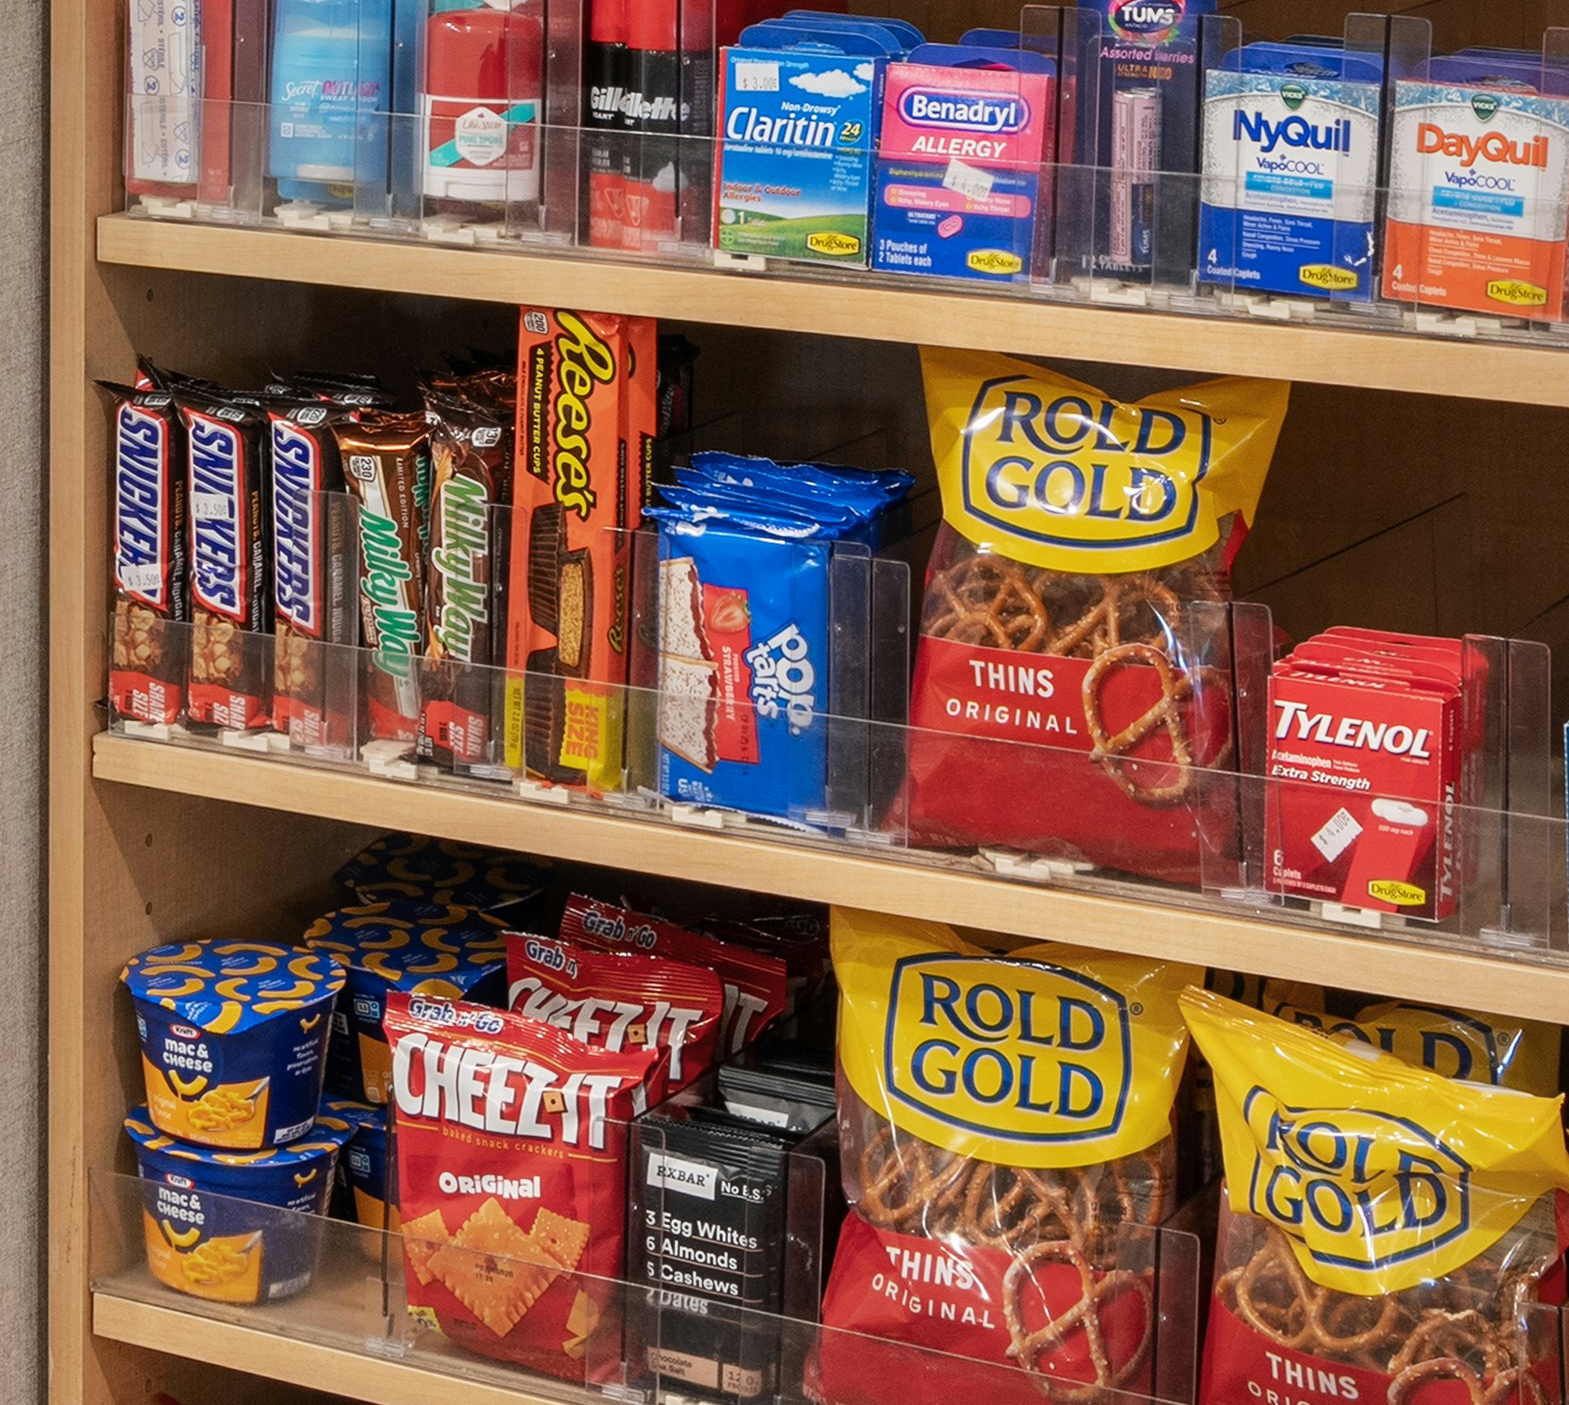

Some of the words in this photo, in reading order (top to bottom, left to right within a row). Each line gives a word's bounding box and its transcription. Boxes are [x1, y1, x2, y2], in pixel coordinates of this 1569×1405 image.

[1122, 6, 1174, 25] TUMS
[1100, 47, 1152, 60] Assorted
[281, 80, 323, 102] Secret
[781, 101, 838, 116] Non-Drowsy
[1282, 89, 1304, 100] VICKS
[1472, 100, 1496, 112] VICKS
[727, 106, 835, 146] Claritin
[841, 122, 861, 136] 24
[912, 94, 1017, 133] Benadryl
[1233, 109, 1351, 155] NyQuil
[911, 136, 1007, 158] ALLERGY
[1416, 122, 1549, 168] DayQuil
[723, 182, 752, 192] Indoor
[764, 185, 801, 196] Outdoor
[723, 192, 761, 202] Allergies
[879, 252, 883, 262] 2
[886, 252, 912, 265] Tablets
[914, 255, 932, 267] each
[886, 241, 917, 253] Pouches
[533, 358, 544, 400] PEANUT
[533, 403, 541, 445] BUTTER
[996, 390, 1187, 455] ROLD
[395, 457, 406, 494] LIMITED
[985, 454, 1177, 523] GOLD
[398, 495, 409, 528] EDITION
[432, 473, 488, 583] Milky
[359, 504, 412, 606] Milky
[435, 582, 488, 663] Way
[373, 610, 421, 679] Way
[722, 646, 735, 721] STRAWBERRY
[968, 659, 1054, 698] THINS
[566, 702, 583, 756] SIZE
[584, 705, 598, 760] KING
[945, 698, 1078, 735] ORIGINAL
[1274, 699, 1430, 758] TYLENOL
[1272, 750, 1332, 769] Acetaminophen
[1272, 765, 1308, 781] Extra
[1311, 770, 1370, 790] Strength
[1441, 782, 1456, 897] TYLENOL
[408, 999, 454, 1025] Grab
[918, 971, 1106, 1054] ROLD
[165, 1038, 193, 1056] mac
[173, 1026, 195, 1037] Kraft
[910, 1036, 1103, 1121] GOLD
[442, 1127, 472, 1144] baked
[476, 1136, 510, 1150] snack
[515, 1142, 565, 1160] crackers
[656, 1164, 706, 1187] RXBAR
[721, 1180, 739, 1196] No
[158, 1187, 188, 1205] mac
[1266, 1165, 1448, 1237] GOLD
[661, 1212, 693, 1237] Egg
[696, 1220, 758, 1250] Whites
[661, 1237, 738, 1271] Almonds
[885, 1245, 976, 1292] THINS
[660, 1264, 739, 1297] Cashews
[871, 1272, 996, 1330] ORIGINAL
[1266, 1350, 1360, 1400] THINS
